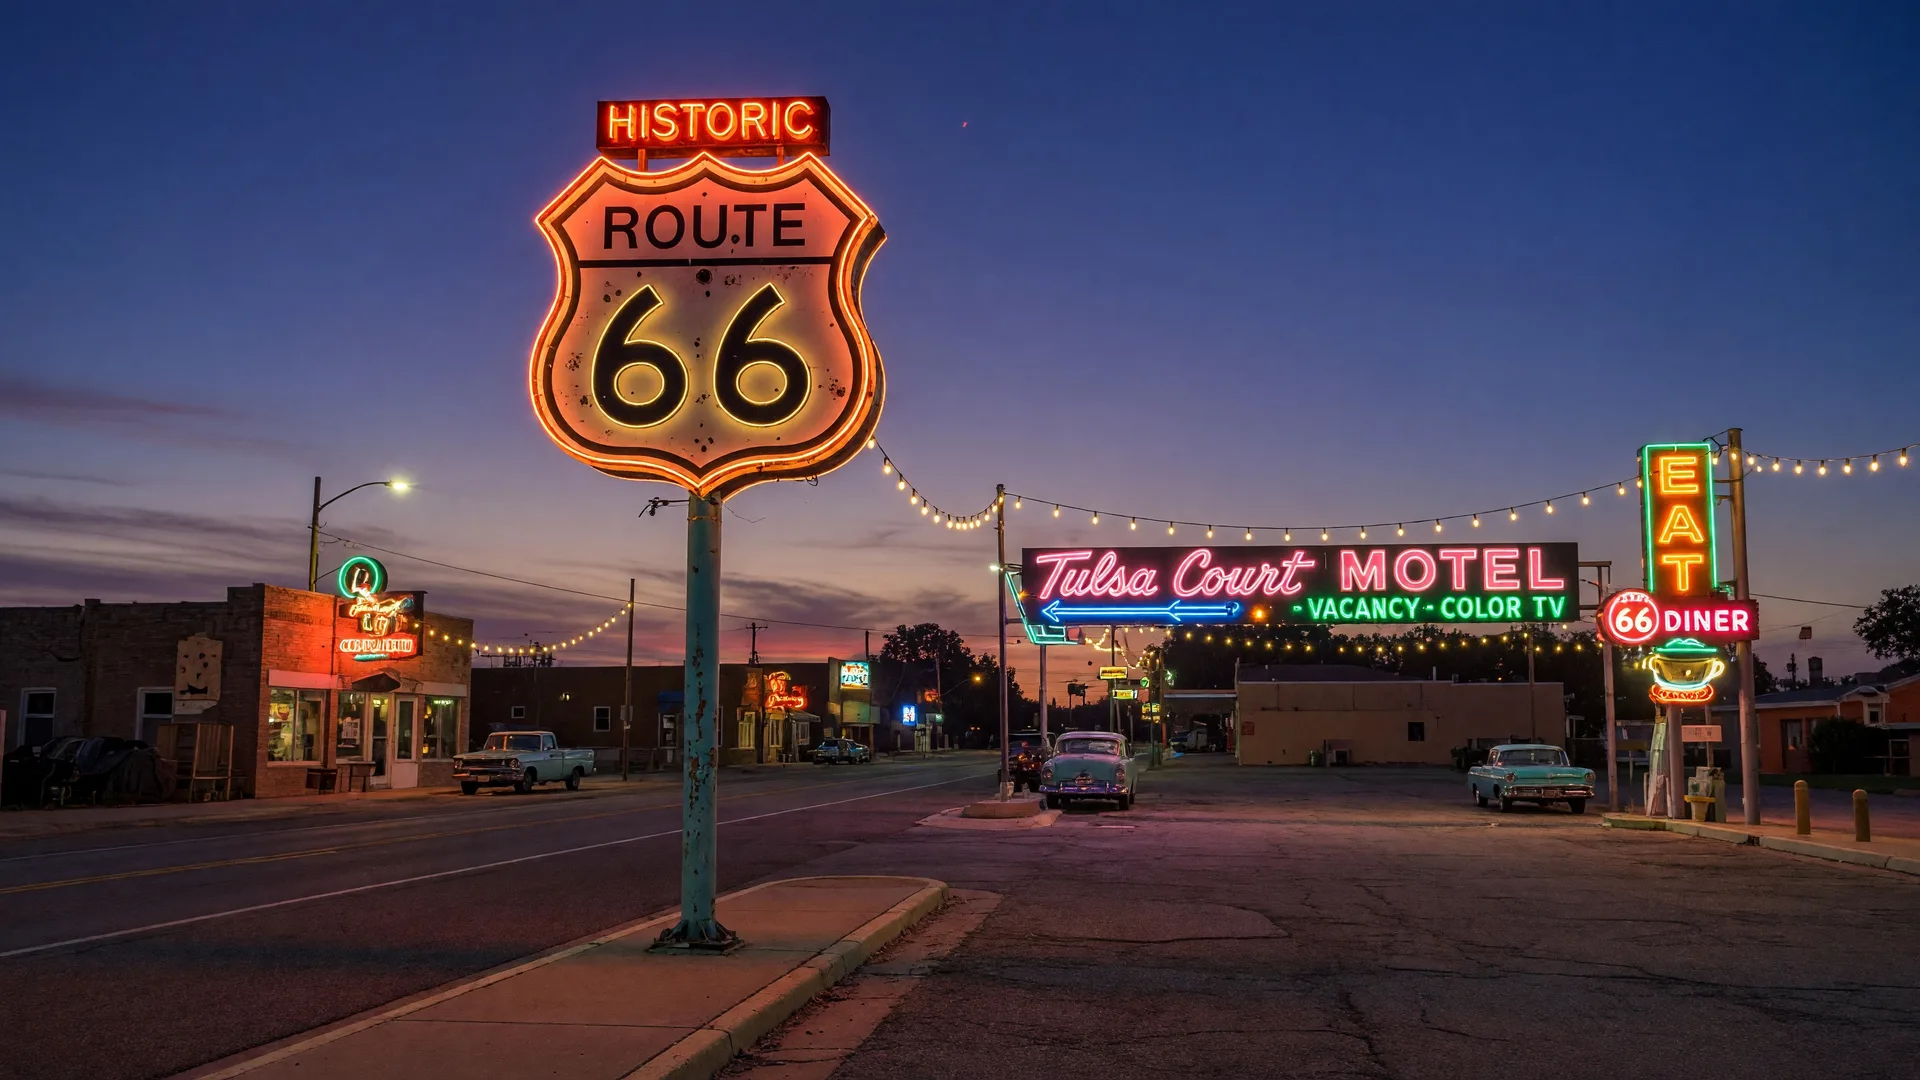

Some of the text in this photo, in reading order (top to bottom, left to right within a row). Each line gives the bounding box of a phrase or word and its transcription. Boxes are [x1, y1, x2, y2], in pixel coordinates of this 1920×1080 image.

[608, 100, 816, 141] HISTORIC
[603, 202, 806, 250] ROUTE
[591, 282, 811, 429] 66
[1658, 456, 1705, 592] EAT
[1036, 548, 1565, 600] Tulsa Court MOTEL
[1532, 596, 1565, 618] TV
[1615, 607, 1750, 633] 66 DINER
